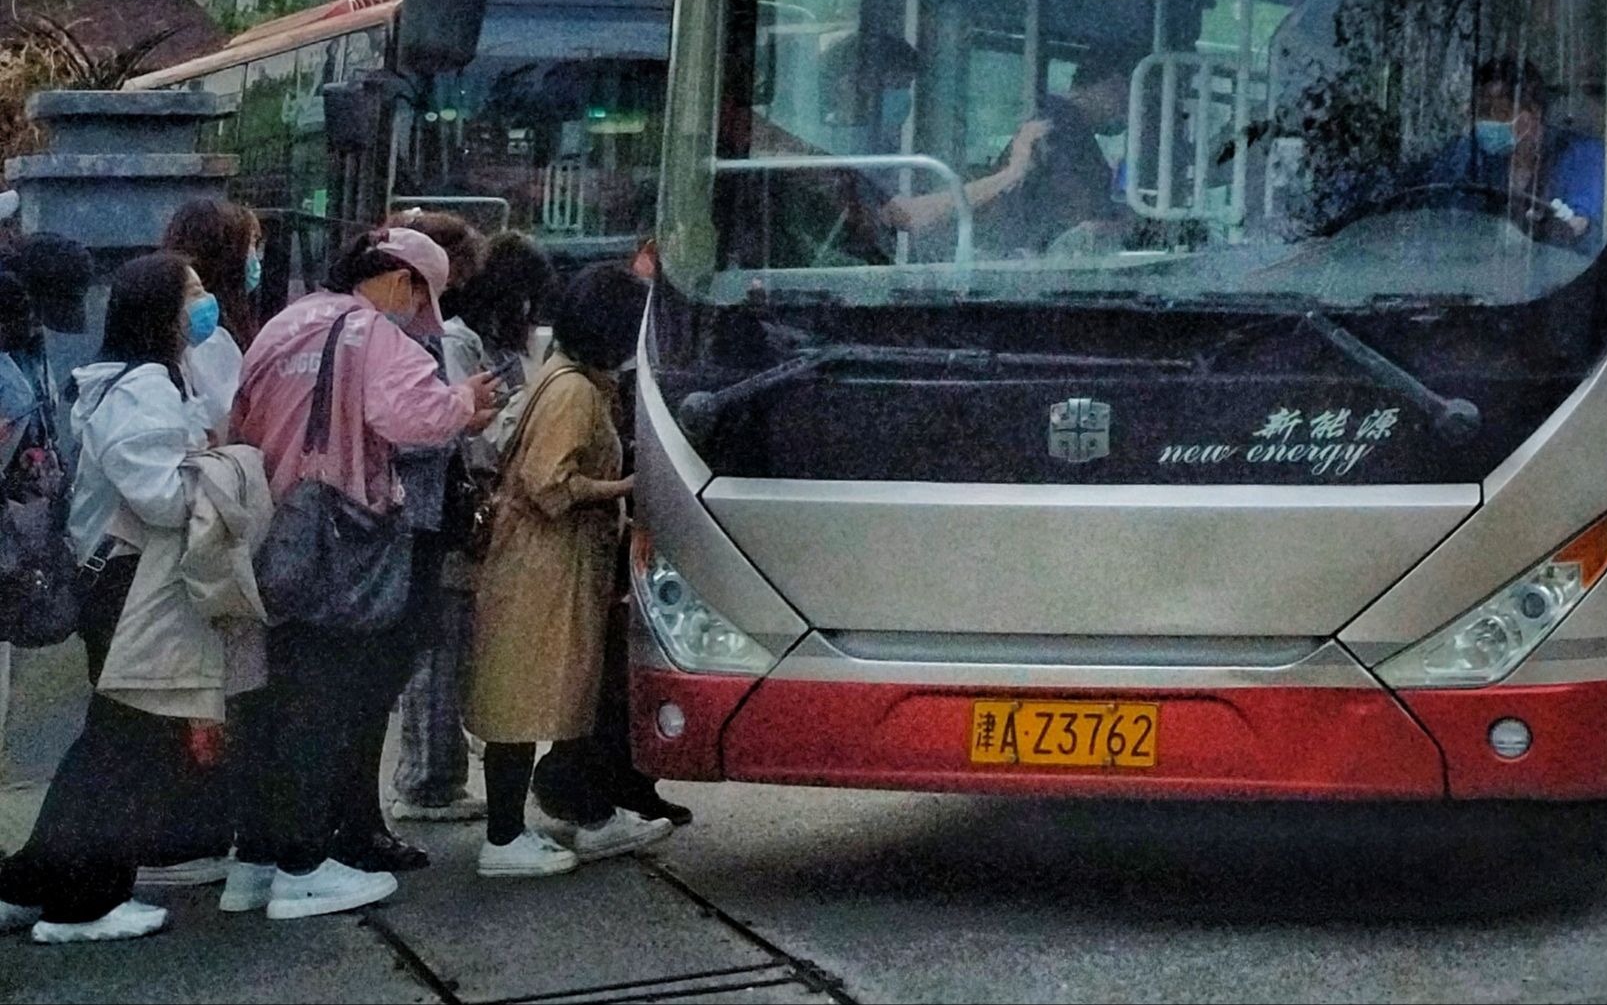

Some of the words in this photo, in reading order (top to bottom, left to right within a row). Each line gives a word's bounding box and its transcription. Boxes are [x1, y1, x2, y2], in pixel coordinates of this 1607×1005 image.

[1252, 407, 1400, 442] 新能源
[1157, 444, 1237, 464] new
[1246, 443, 1374, 476] energy
